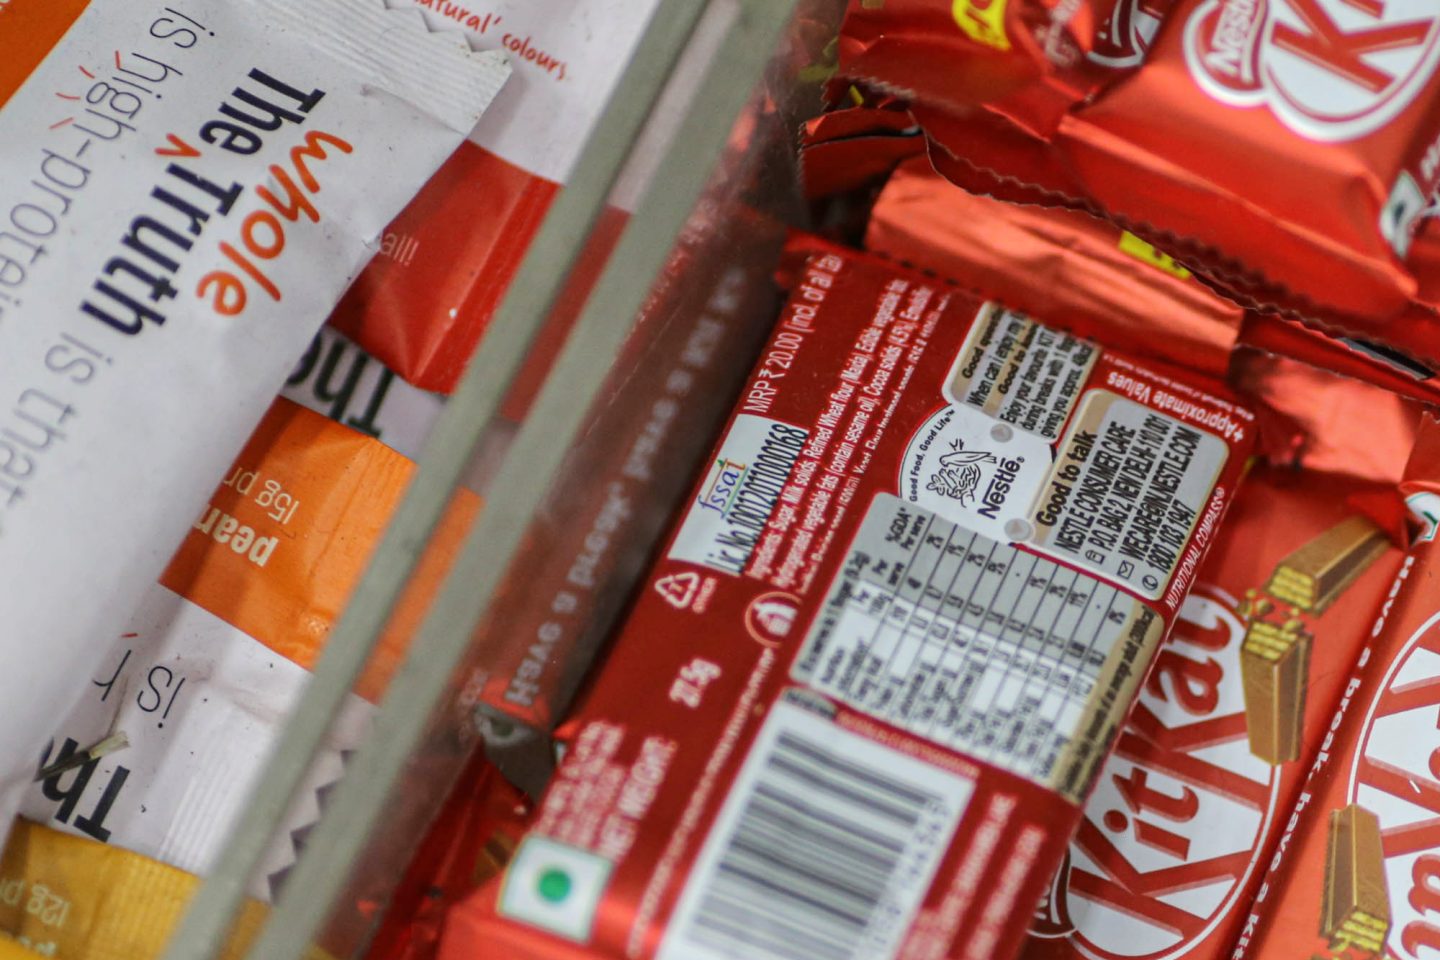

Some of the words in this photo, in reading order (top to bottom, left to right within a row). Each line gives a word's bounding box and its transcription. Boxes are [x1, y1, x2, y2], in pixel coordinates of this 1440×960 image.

[148, 7, 215, 51] is
[199, 67, 327, 158] The
[196, 129, 354, 318] whole
[79, 161, 244, 338] Truth
[784, 296, 825, 338] (incl.
[44, 331, 114, 385] is
[765, 327, 806, 373] 20.00
[874, 341, 904, 373] solids
[960, 346, 985, 380] Good
[284, 328, 398, 437] Th
[742, 376, 782, 419] MRP
[829, 378, 856, 404] flour
[861, 364, 892, 398] Cocoa
[965, 375, 994, 409] When
[981, 357, 1004, 383] can
[995, 362, 1021, 396] Good
[816, 396, 847, 430] Wheat
[839, 407, 872, 445] sesame
[998, 396, 1026, 426] Enjoy
[1018, 401, 1046, 433] during
[1036, 409, 1064, 440] giving
[801, 423, 834, 461] Refined
[822, 437, 859, 478] (contain
[1065, 426, 1098, 465] talk
[693, 451, 752, 521] fssai
[815, 469, 840, 492] fats
[1055, 458, 1083, 484] to
[1072, 447, 1124, 515] CONSUMER
[1101, 419, 1136, 457] CARE
[975, 455, 1022, 521] Nestlé
[1033, 479, 1073, 530] Good
[1110, 470, 1145, 504] NEW
[1095, 502, 1129, 533] BAG
[1164, 498, 1198, 531] 1947
[1157, 523, 1186, 549] 103
[1145, 539, 1179, 575] 1800
[1161, 544, 1204, 611] NUTRITIONAL
[128, 661, 187, 731] is
[20, 730, 137, 843] Th
